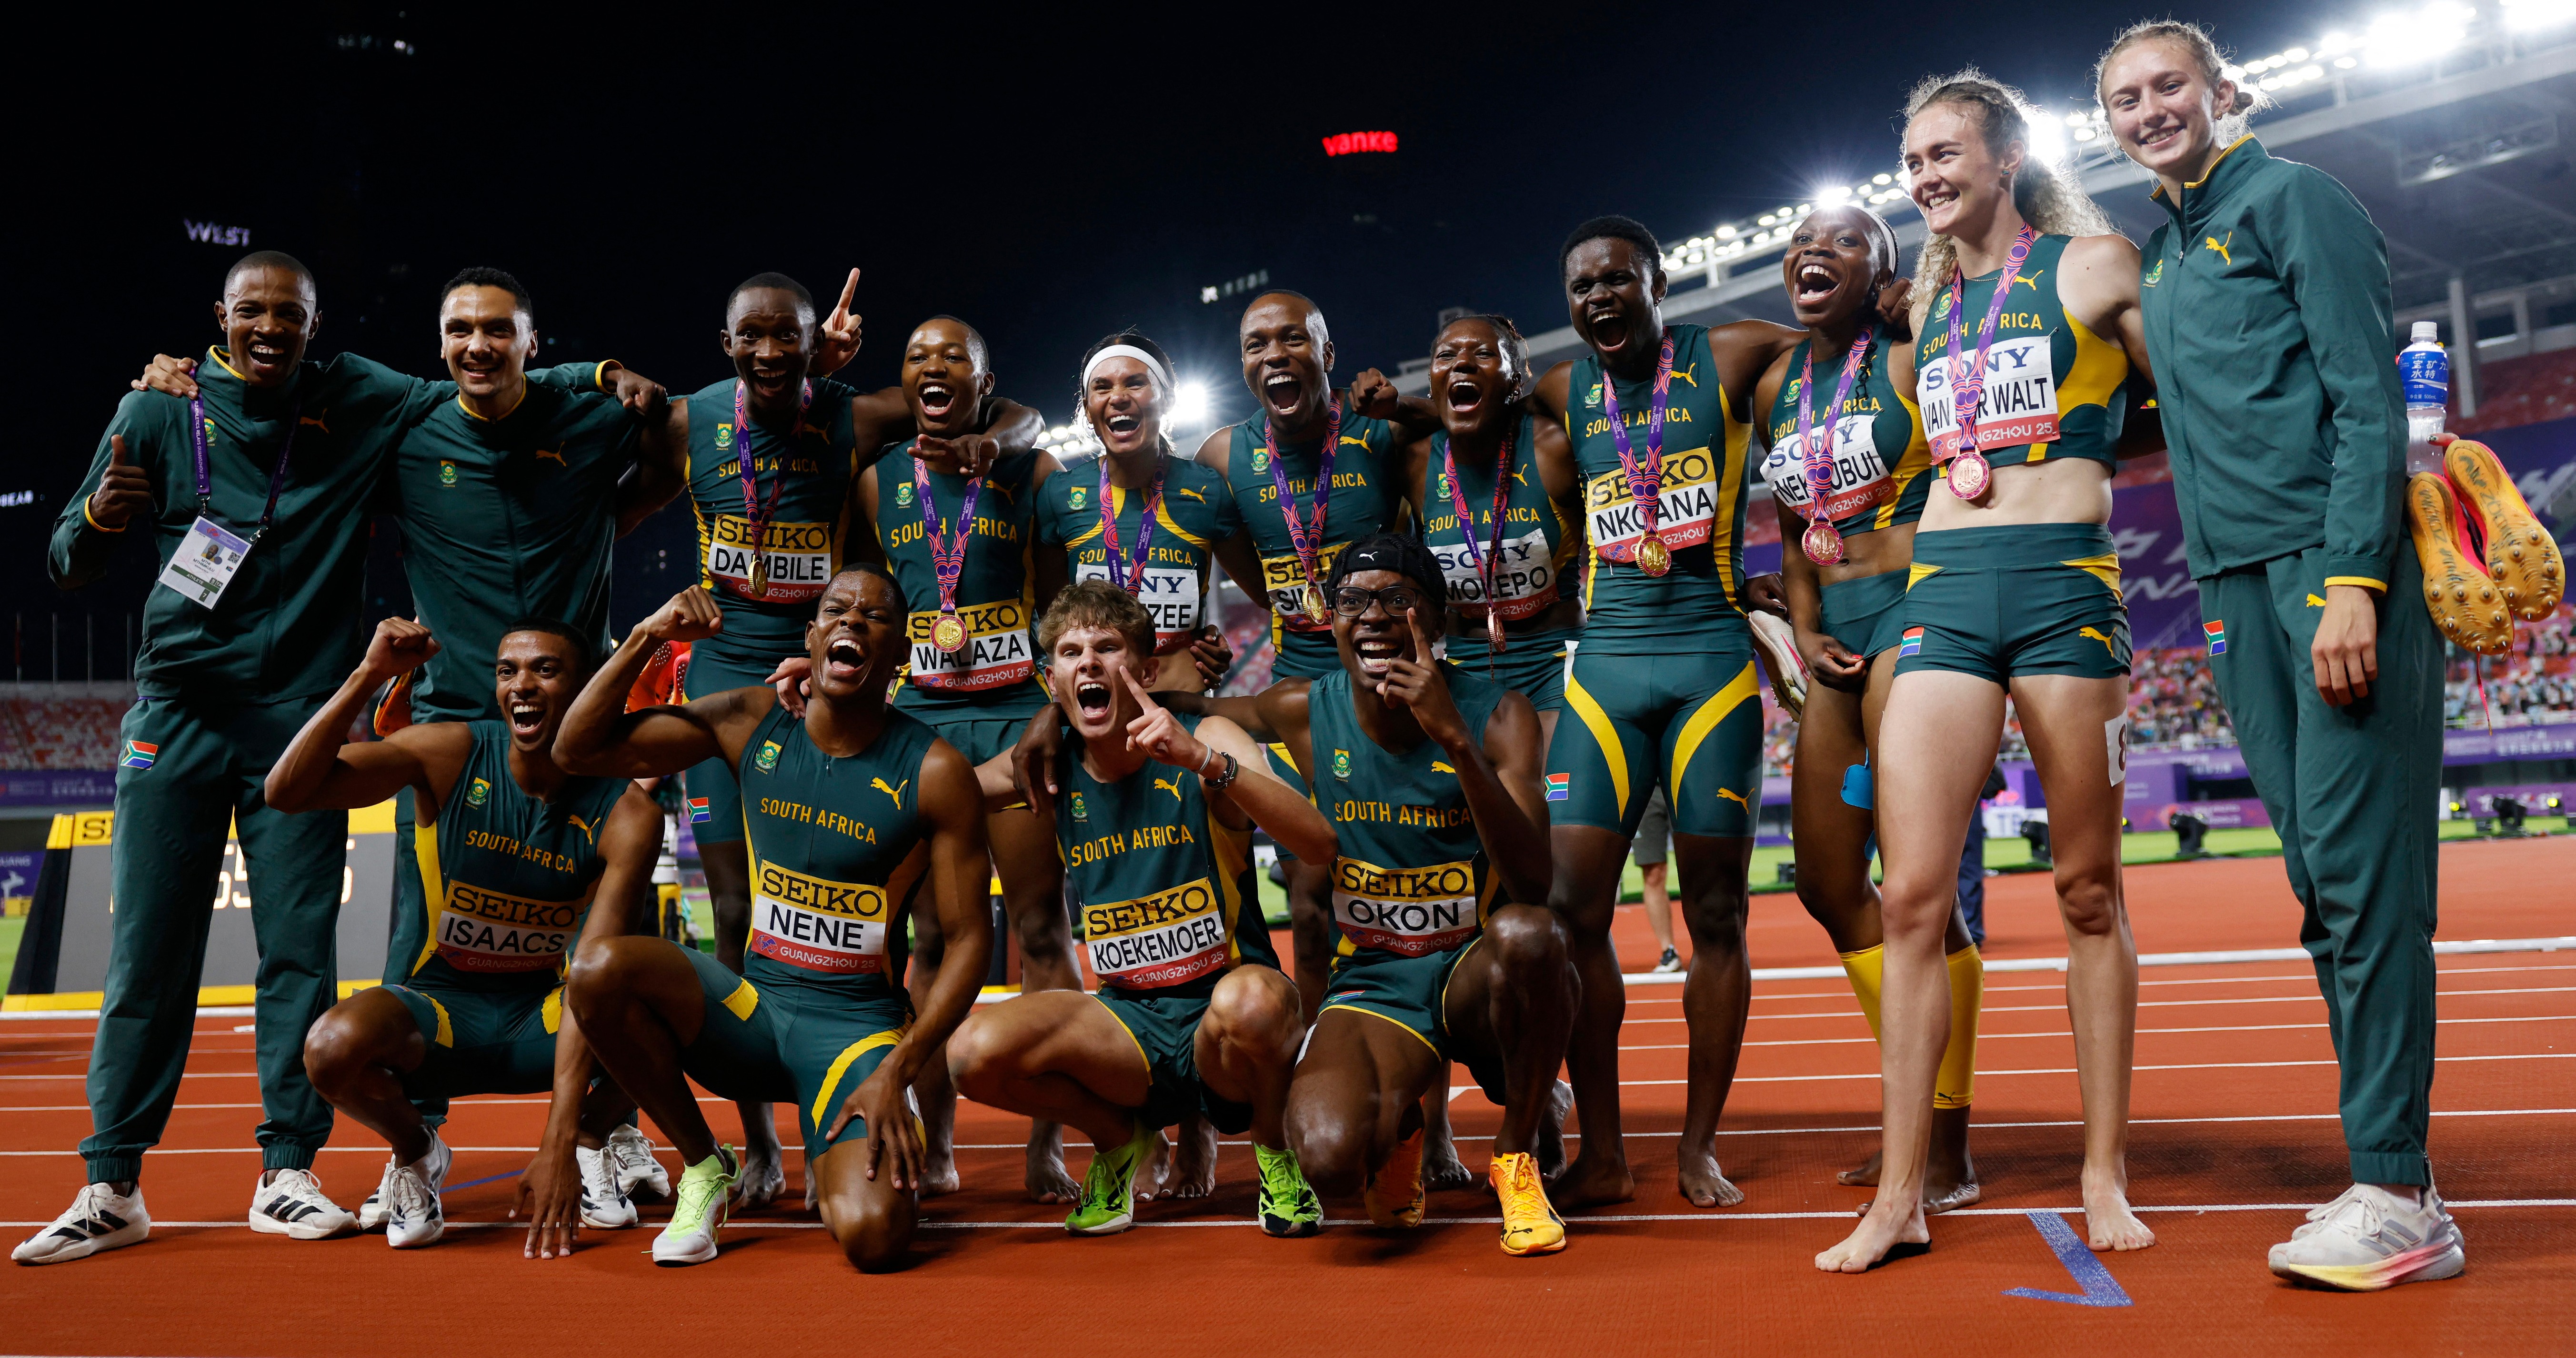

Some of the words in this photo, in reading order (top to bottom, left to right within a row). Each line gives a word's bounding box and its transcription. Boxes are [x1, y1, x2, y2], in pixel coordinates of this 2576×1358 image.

[1322, 131, 1399, 156] vanke
[1923, 322, 1969, 361] SOUH
[1977, 312, 2043, 333] ARICA
[2411, 369, 2436, 379] 水特
[1823, 397, 1881, 420] ARICA
[1924, 397, 1950, 433] VAN
[1992, 377, 2047, 414] WALT
[1585, 413, 1629, 437] SOUH
[1636, 408, 1692, 425] AFICA
[2036, 422, 2053, 435] 25
[719, 457, 763, 477] SOUH
[770, 457, 819, 474] ARICA
[1592, 455, 1708, 508] SEKO
[1260, 479, 1305, 502] SOTH
[1875, 484, 1890, 495] 25
[1483, 507, 1541, 524] ARICA
[891, 517, 947, 548] SOUH
[955, 516, 1017, 543] FRICA
[1079, 548, 1127, 564] SOUH
[1148, 548, 1193, 566] FRICA
[186, 573, 204, 585] ATHLETE
[1446, 566, 1547, 600] MOLEPO
[1472, 599, 1540, 615] GUNGZHOU
[1543, 592, 1553, 602] 25
[912, 605, 1019, 639] SIKO
[916, 634, 1025, 671] WALAZA
[945, 669, 1014, 687] GUANGZHOU
[1017, 666, 1029, 676] 25
[761, 797, 812, 823] SOUTH
[816, 810, 876, 845] AFRICA
[1335, 800, 1391, 822] SOUTH
[1399, 805, 1471, 827] AFRICA
[465, 830, 520, 855] SOUTH
[521, 845, 574, 874] AFRICA
[1071, 833, 1125, 866] SOUTH
[1133, 824, 1194, 850] AFRICA
[762, 868, 882, 917] SEIKO
[1340, 863, 1467, 898] SEIKO
[449, 885, 576, 928] SEIKO
[1088, 886, 1209, 936] SEIKO
[1348, 900, 1459, 931] OKON
[444, 916, 565, 953] ISAACS
[770, 904, 864, 949] NENE
[1372, 935, 1452, 951] GUANGZHOU
[1456, 932, 1469, 942] 25
[780, 946, 857, 969] GUANGZHOU
[861, 960, 875, 969] 25
[1094, 917, 1220, 971] KOEKEMOER
[467, 956, 543, 969] GUANGZHOU
[1133, 956, 1208, 984] GUANGZHOU
[1211, 951, 1224, 963] 25
